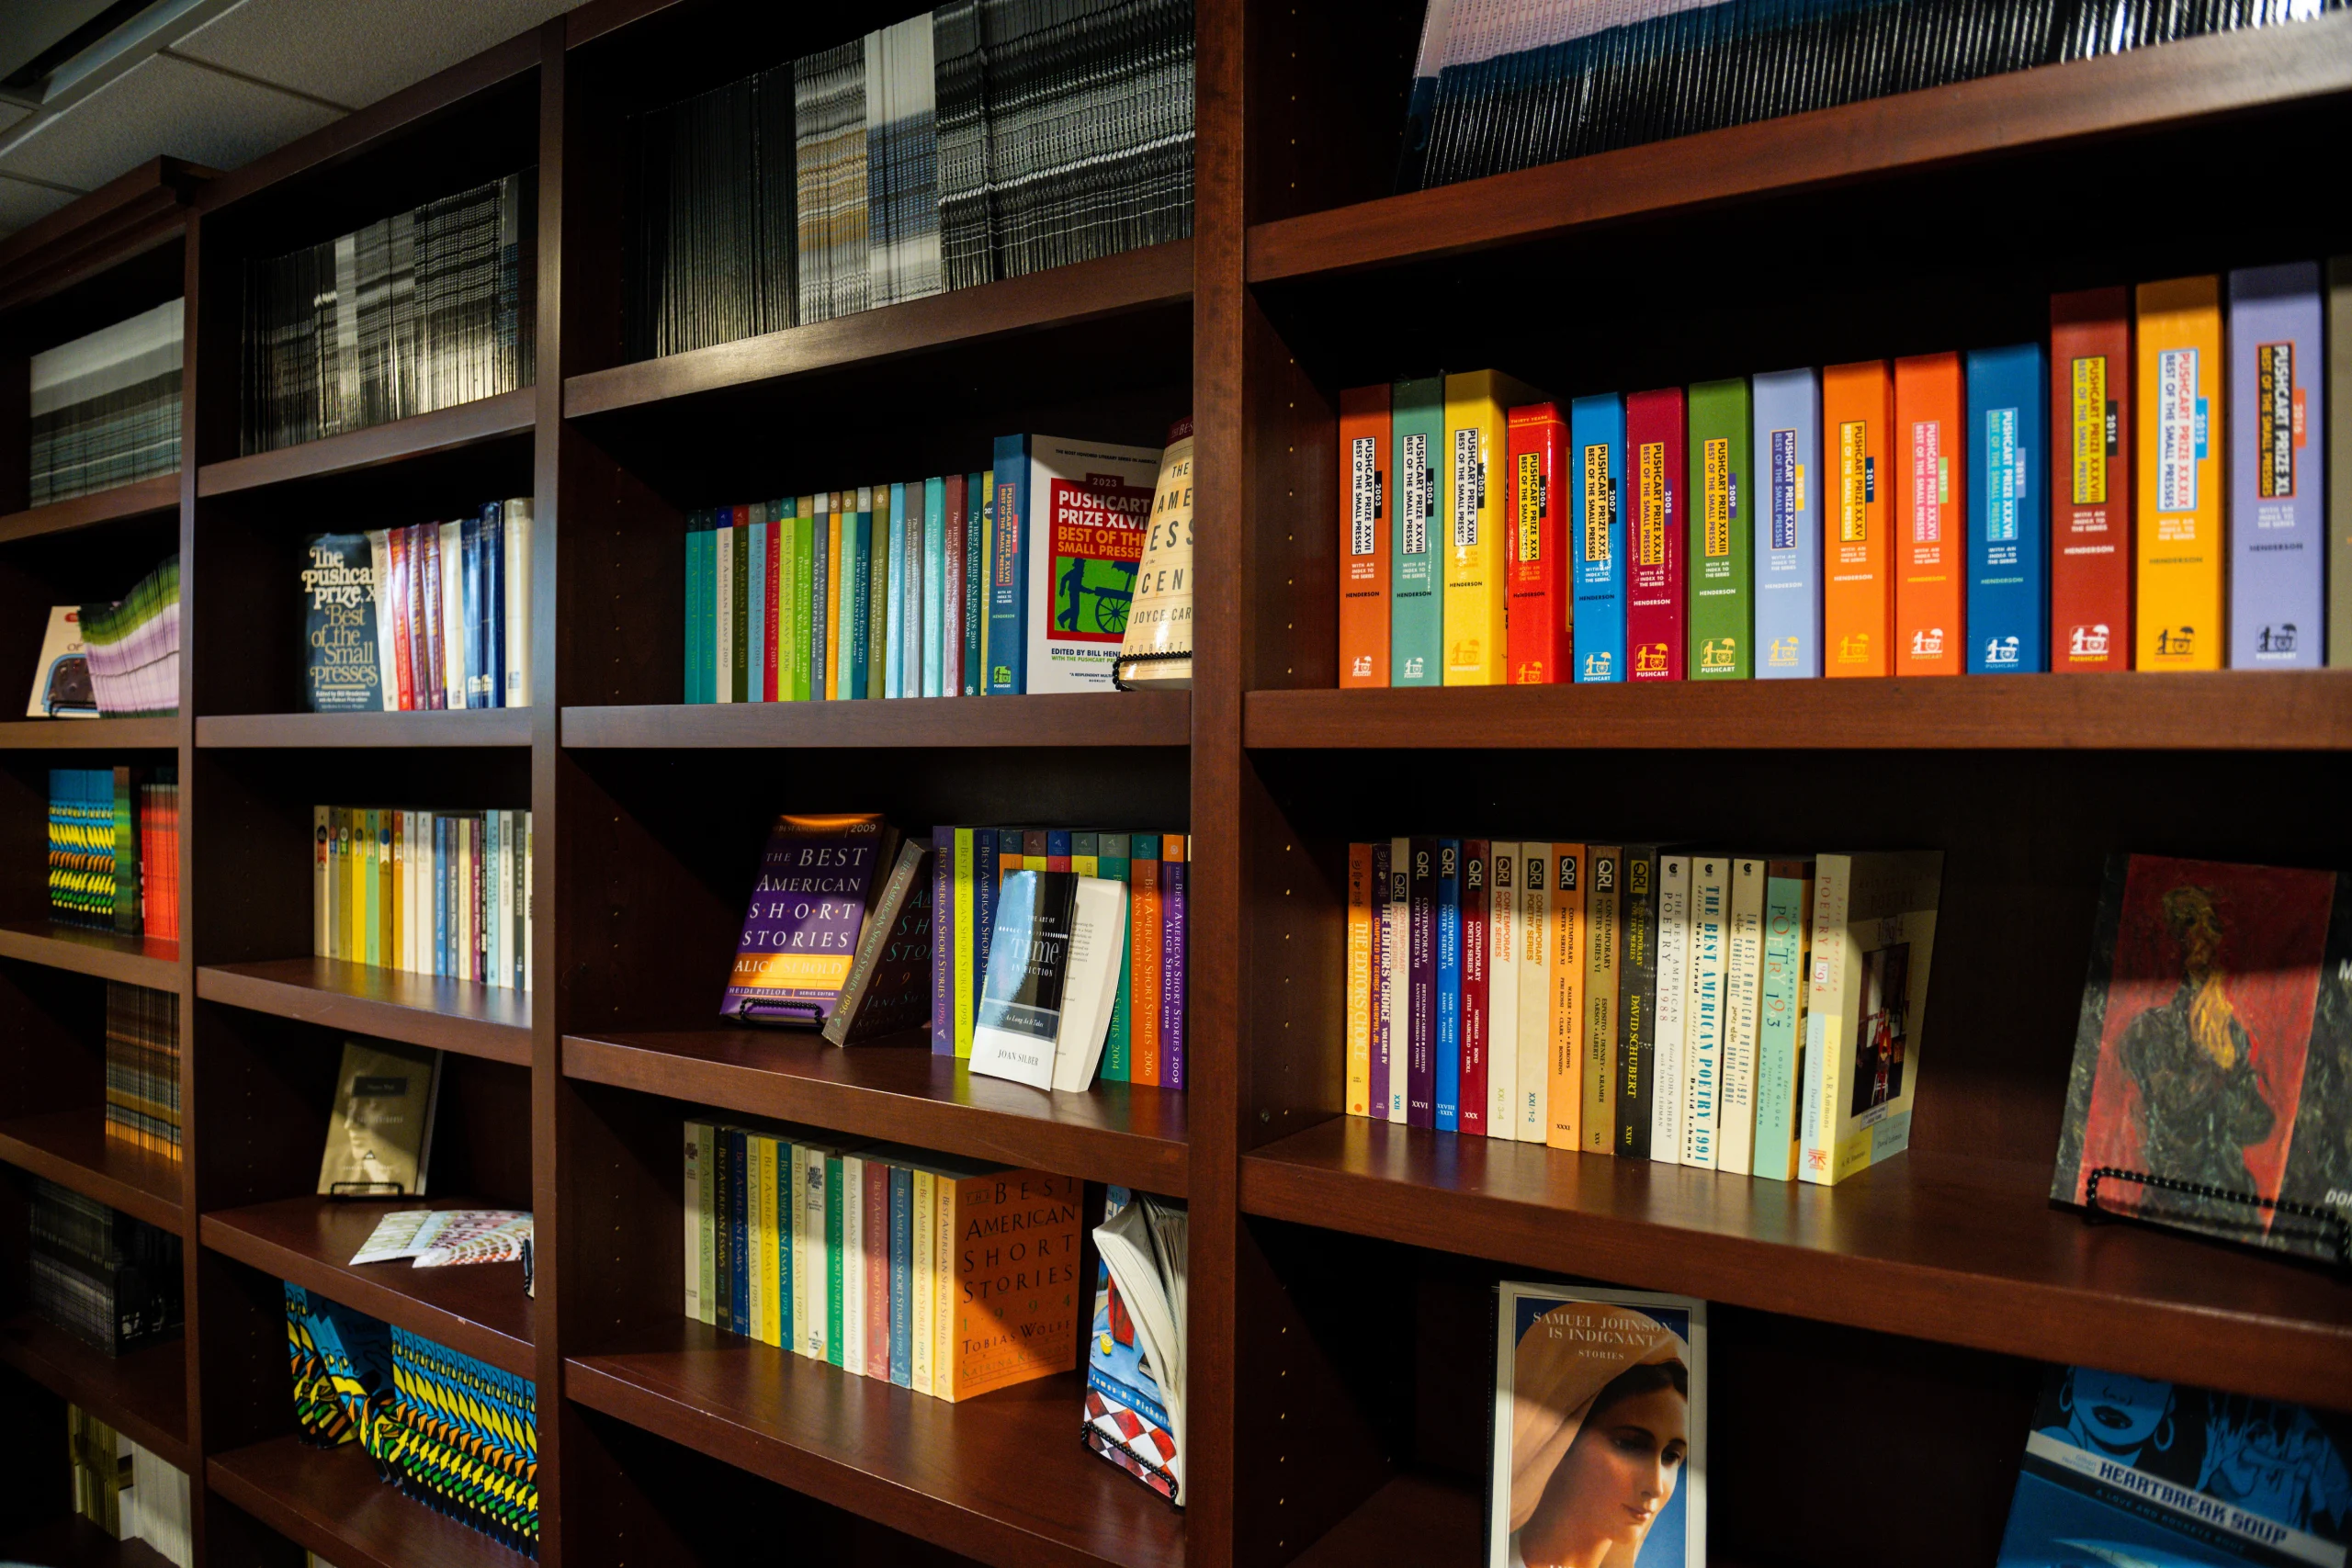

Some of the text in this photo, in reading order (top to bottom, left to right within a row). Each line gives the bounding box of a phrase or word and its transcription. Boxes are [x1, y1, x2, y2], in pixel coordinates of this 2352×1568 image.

[2275, 346, 2289, 425] PUSHCART
[2089, 360, 2099, 502] PUSHCART PRIZE XXXVIII
[2107, 415, 2115, 442] 2014
[2165, 355, 2175, 507] BEST OF THE SMALL PRESSES
[2178, 353, 2190, 507] PUSHCART PRIZE XXXIX
[2275, 431, 2290, 473] PRIZE
[1172, 462, 1189, 478] THE
[1356, 461, 1362, 471] OF
[1093, 478, 1116, 487] 2023
[1059, 491, 1150, 513] PUSHCART
[1158, 488, 1192, 513] AME
[1058, 508, 1102, 526] PRIZE
[1058, 526, 1091, 542] BEST
[1095, 529, 1116, 544] OF
[1149, 520, 1193, 551] ESS
[310, 545, 344, 569] The
[1057, 541, 1141, 558] SMALL PRESSE
[1141, 569, 1183, 593] CEN
[325, 604, 366, 626] Best
[1134, 607, 1191, 624] JOYCE CAR
[311, 625, 360, 647] of the
[324, 641, 374, 665] Small
[851, 824, 876, 832] 2009
[766, 848, 867, 865] THE BEST
[757, 874, 860, 891] AMERICAN
[1561, 858, 1575, 887] QRL
[1598, 860, 1612, 890] QRL
[1633, 863, 1646, 891] QRL
[1145, 879, 1153, 903] BEST
[742, 931, 852, 947] STORIES
[1145, 908, 1153, 961] AMERICAN
[734, 961, 842, 974] ALICE SEBOLD
[1660, 893, 1672, 1021] POETRY 1988
[1766, 904, 1790, 1027] POETRY 1993
[1024, 964, 1053, 976] FICTION
[1736, 914, 1757, 1105] THE BEST AMERICAN POETRY 1992
[1145, 1003, 1153, 1043] STORIES
[1695, 886, 1719, 1161] THE BEST AMERICAN POETRY 1991
[998, 1049, 1038, 1066] JOAN SILBER
[1628, 995, 1640, 1098] DAVID SCHUBERT
[995, 1177, 1073, 1203] BEST
[966, 1205, 1075, 1240] AMERICAN
[964, 1235, 1073, 1272] SHORT
[964, 1264, 1073, 1303] STORIES
[1532, 1312, 1671, 1336] SAMUEL JOHNSON
[963, 1320, 1069, 1354] TOBIAS WOLFF
[1549, 1327, 1656, 1347] IS INDIGNANT
[1578, 1350, 1624, 1359] STORIES
[1092, 1374, 1116, 1393] James
[1122, 1391, 1130, 1401] H.
[2100, 1461, 2226, 1524] HEARTBREAK
[2231, 1512, 2287, 1544] SOUP
